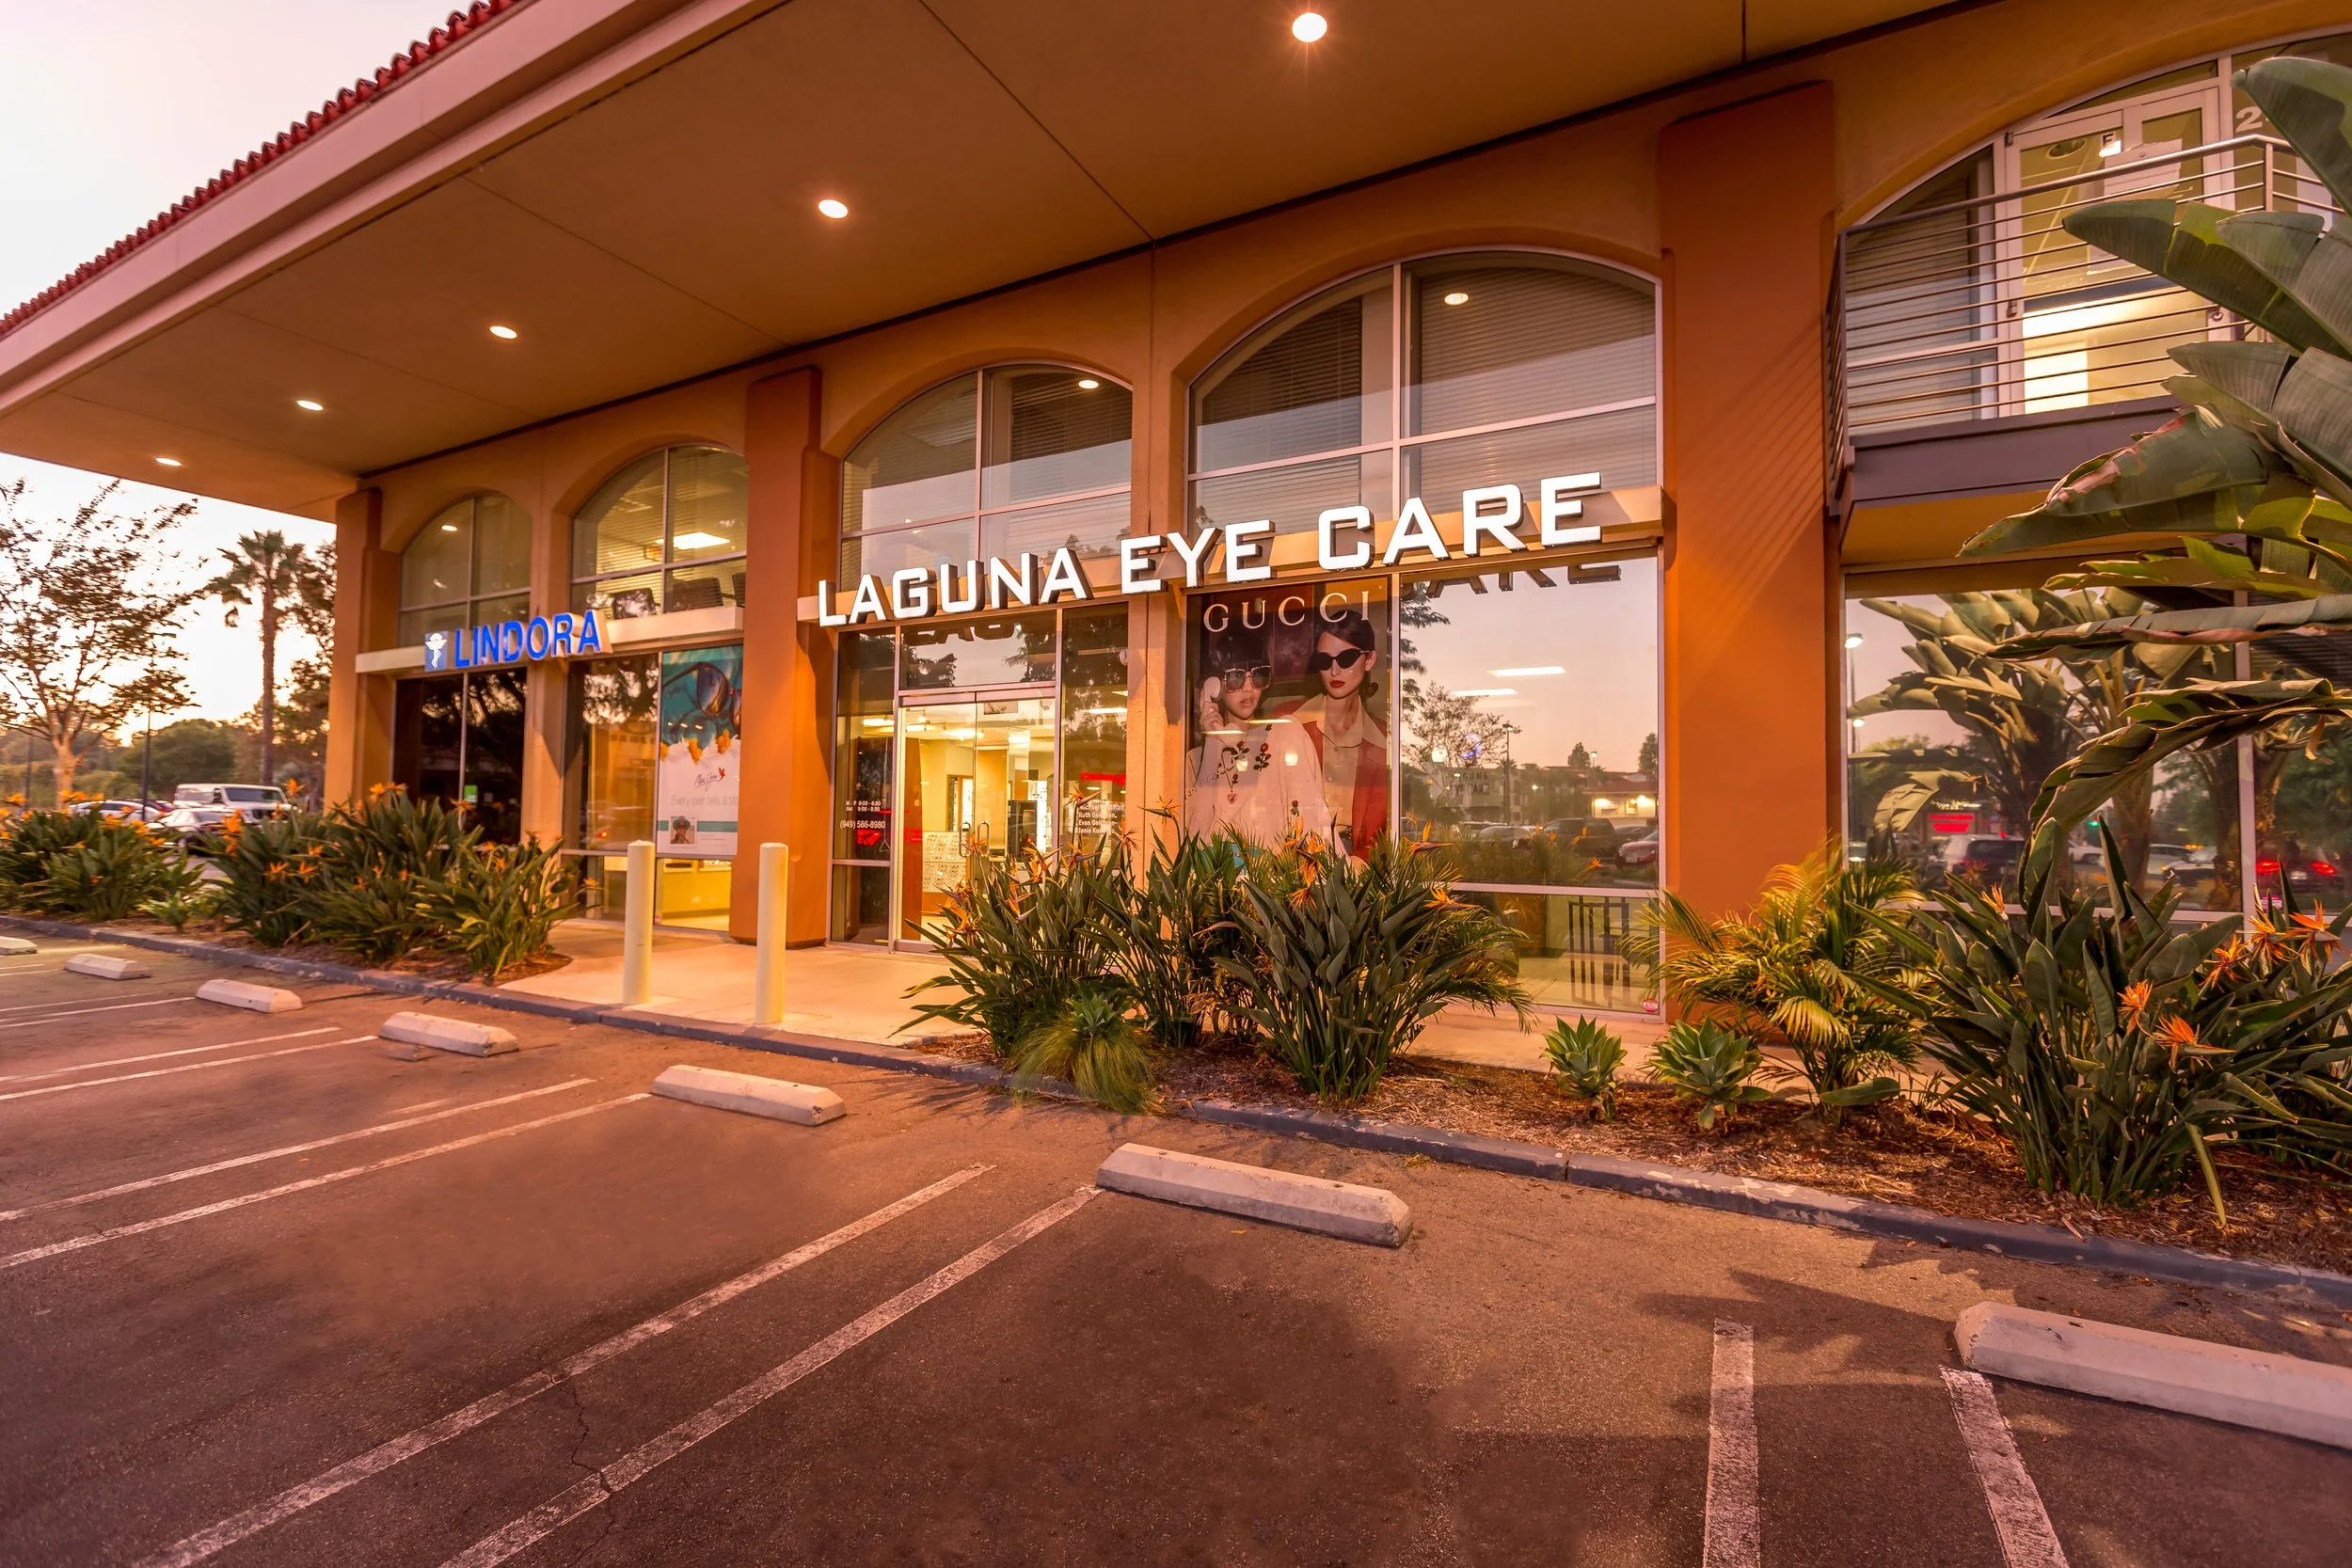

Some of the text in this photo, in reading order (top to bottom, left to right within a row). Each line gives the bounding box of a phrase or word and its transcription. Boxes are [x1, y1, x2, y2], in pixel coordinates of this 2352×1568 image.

[2235, 105, 2268, 133] 2
[818, 471, 1603, 627] LAGUNA EYE CARE
[1203, 591, 1370, 633] GUCCI
[454, 608, 602, 669] LINDORA
[671, 795, 690, 807] Every
[840, 820, 885, 830] (949) 586-8980
